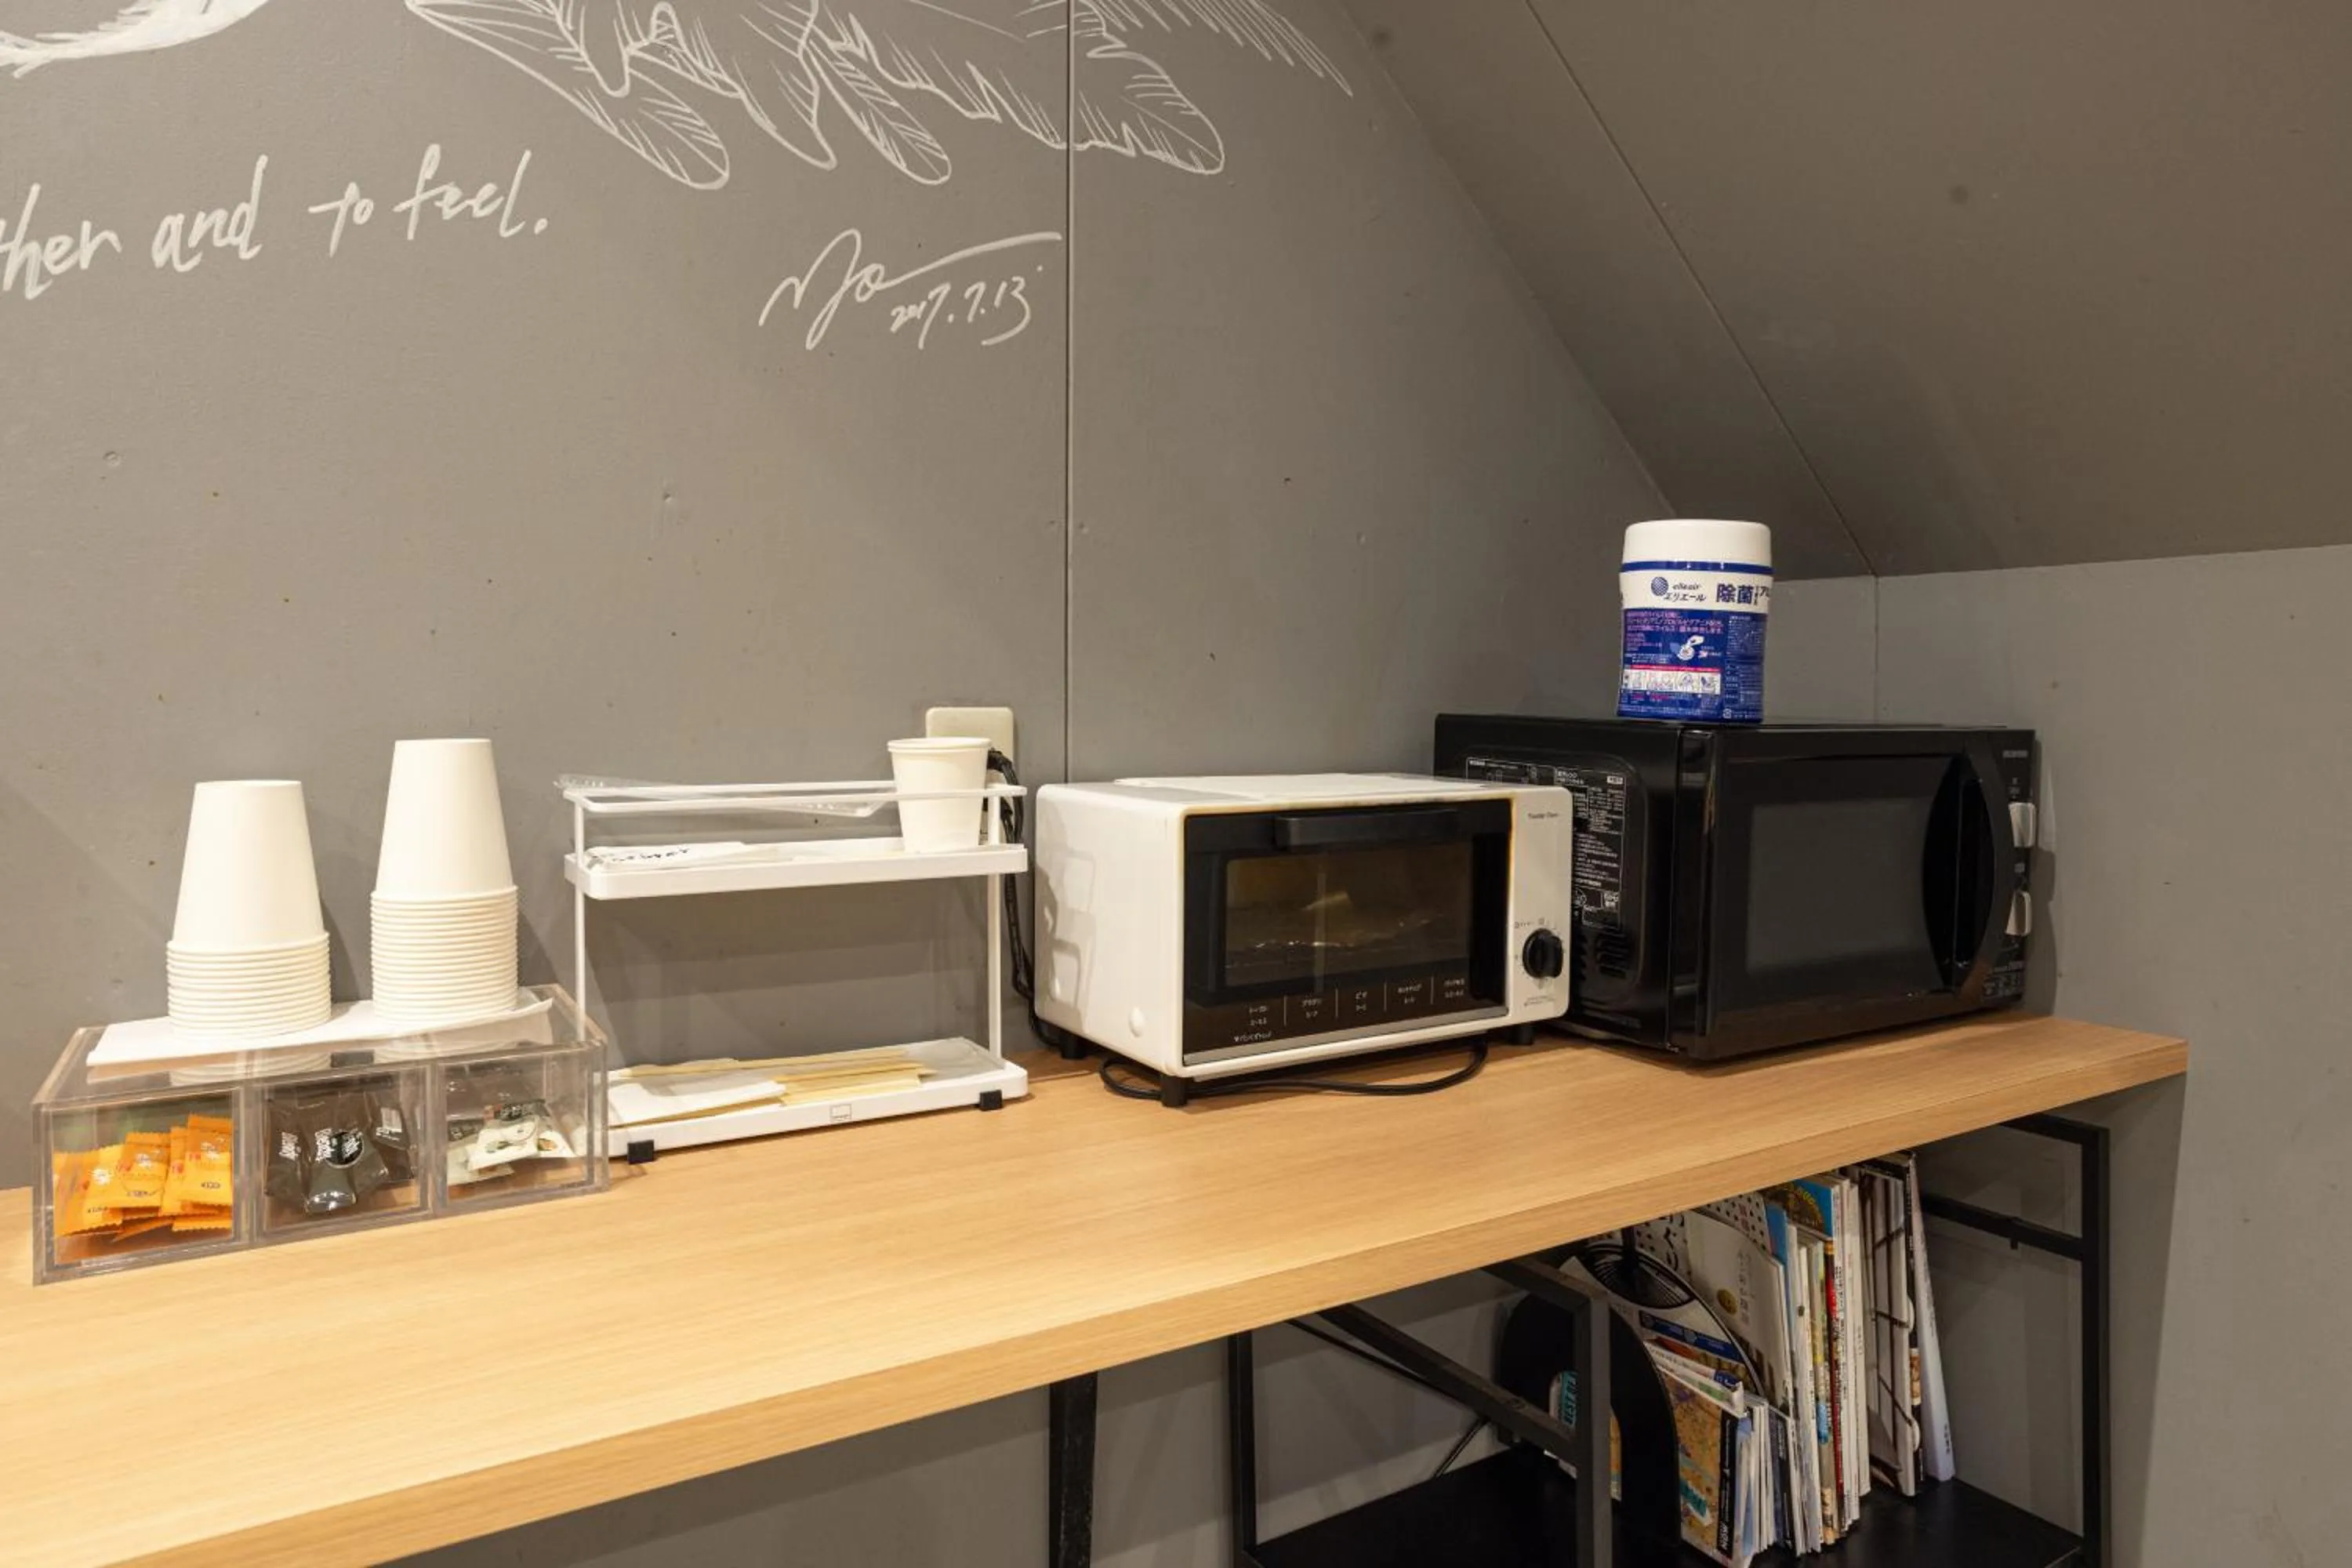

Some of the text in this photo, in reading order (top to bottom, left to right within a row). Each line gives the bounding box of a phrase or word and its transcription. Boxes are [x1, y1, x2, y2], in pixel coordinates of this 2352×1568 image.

[152, 154, 268, 272] and
[309, 181, 374, 257] to
[394, 144, 547, 240] feel.
[1664, 593, 1707, 602] エリエール
